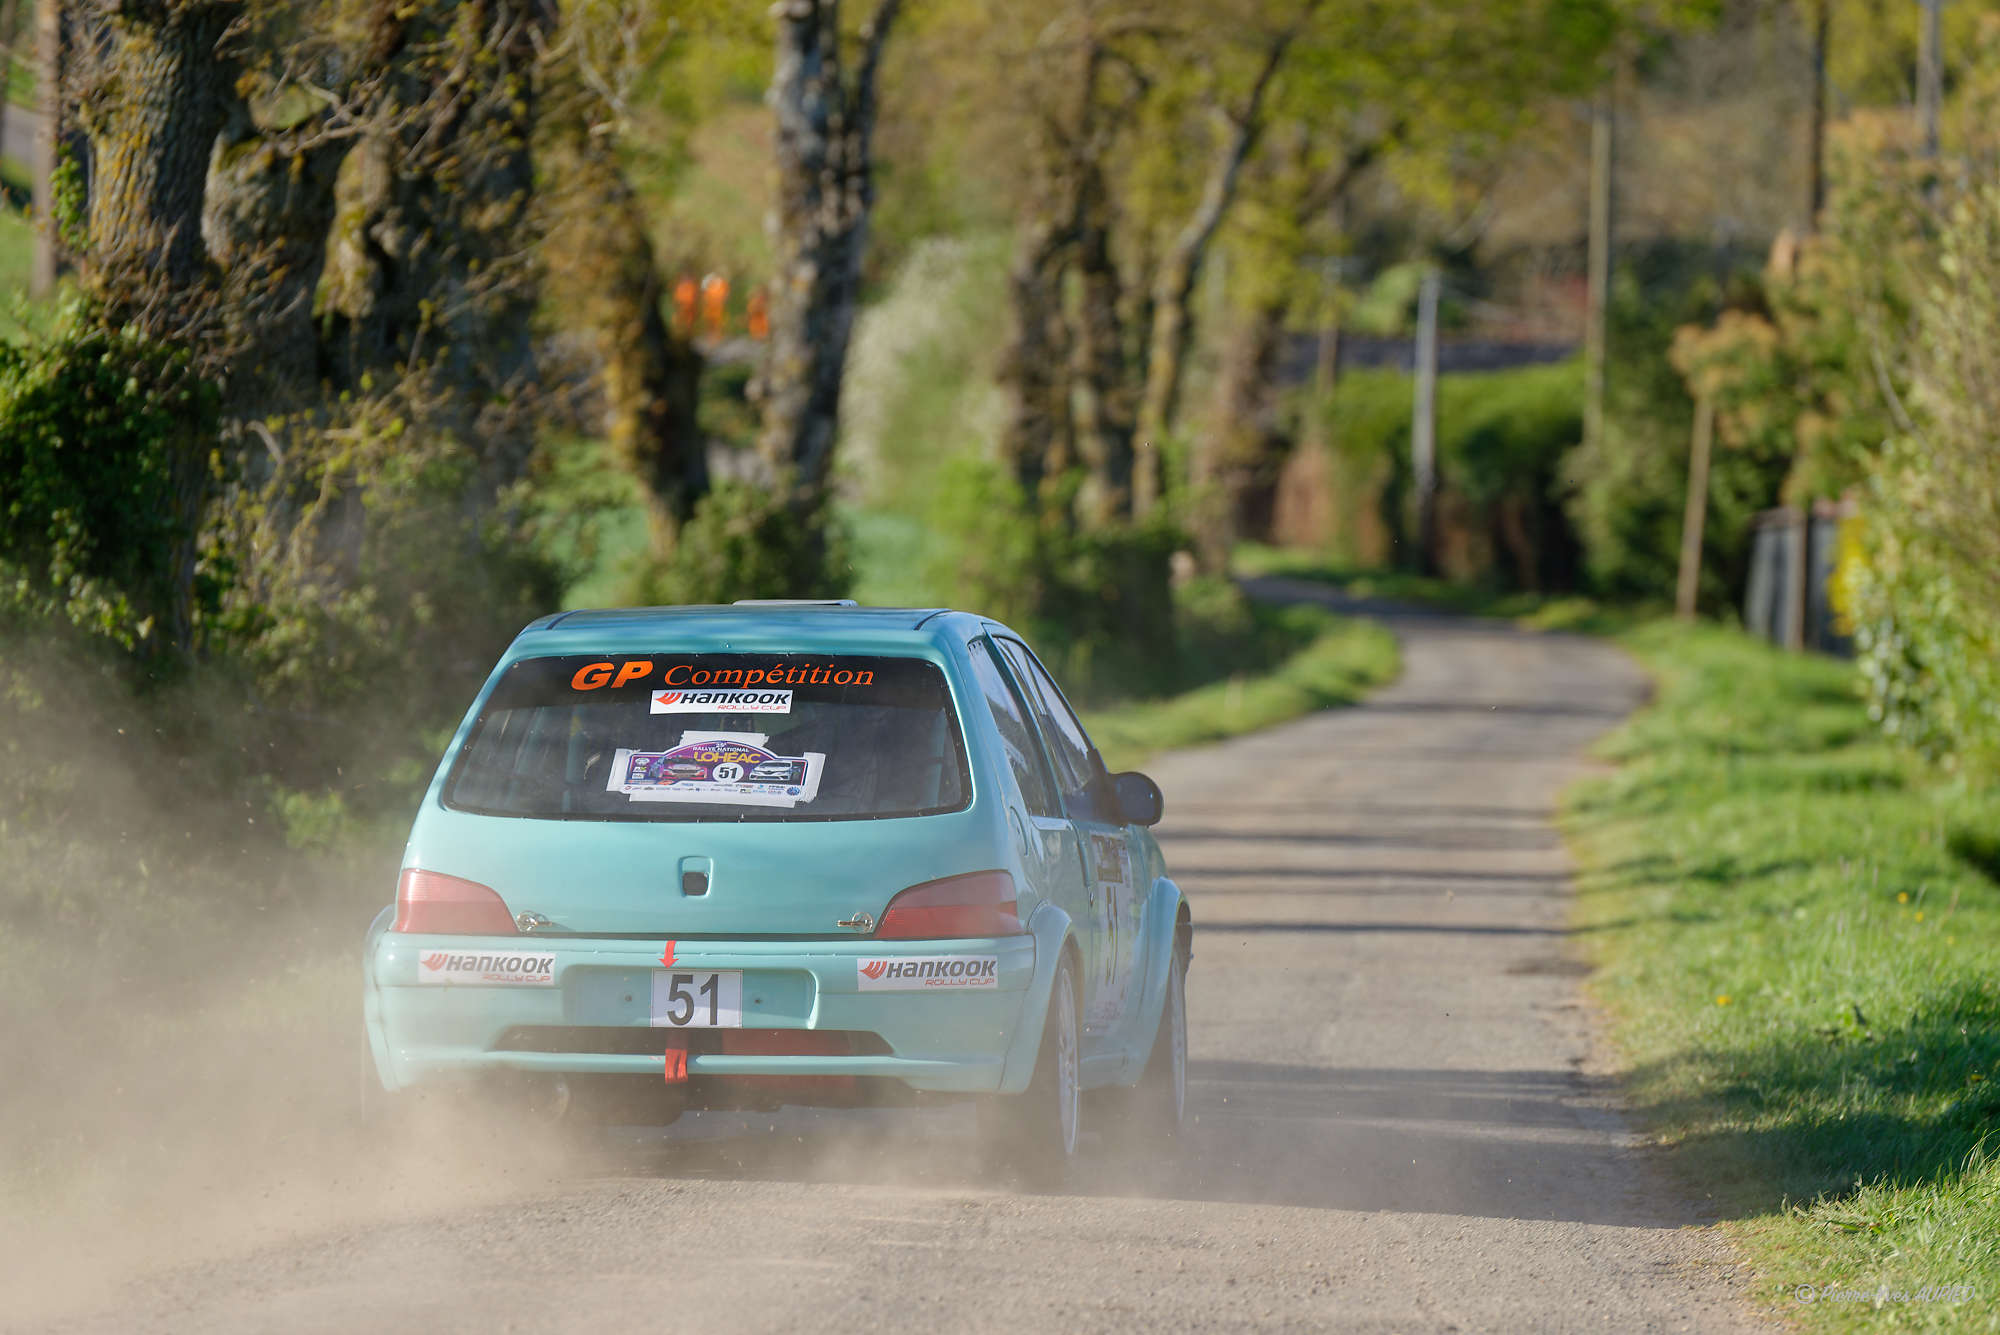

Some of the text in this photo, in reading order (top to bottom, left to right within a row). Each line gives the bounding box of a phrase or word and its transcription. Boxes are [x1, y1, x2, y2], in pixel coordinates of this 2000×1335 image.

[571, 661, 875, 691] GP Compétition
[694, 751, 761, 764] LOHÉAC
[719, 767, 738, 779] 51
[666, 973, 720, 1027] 51
